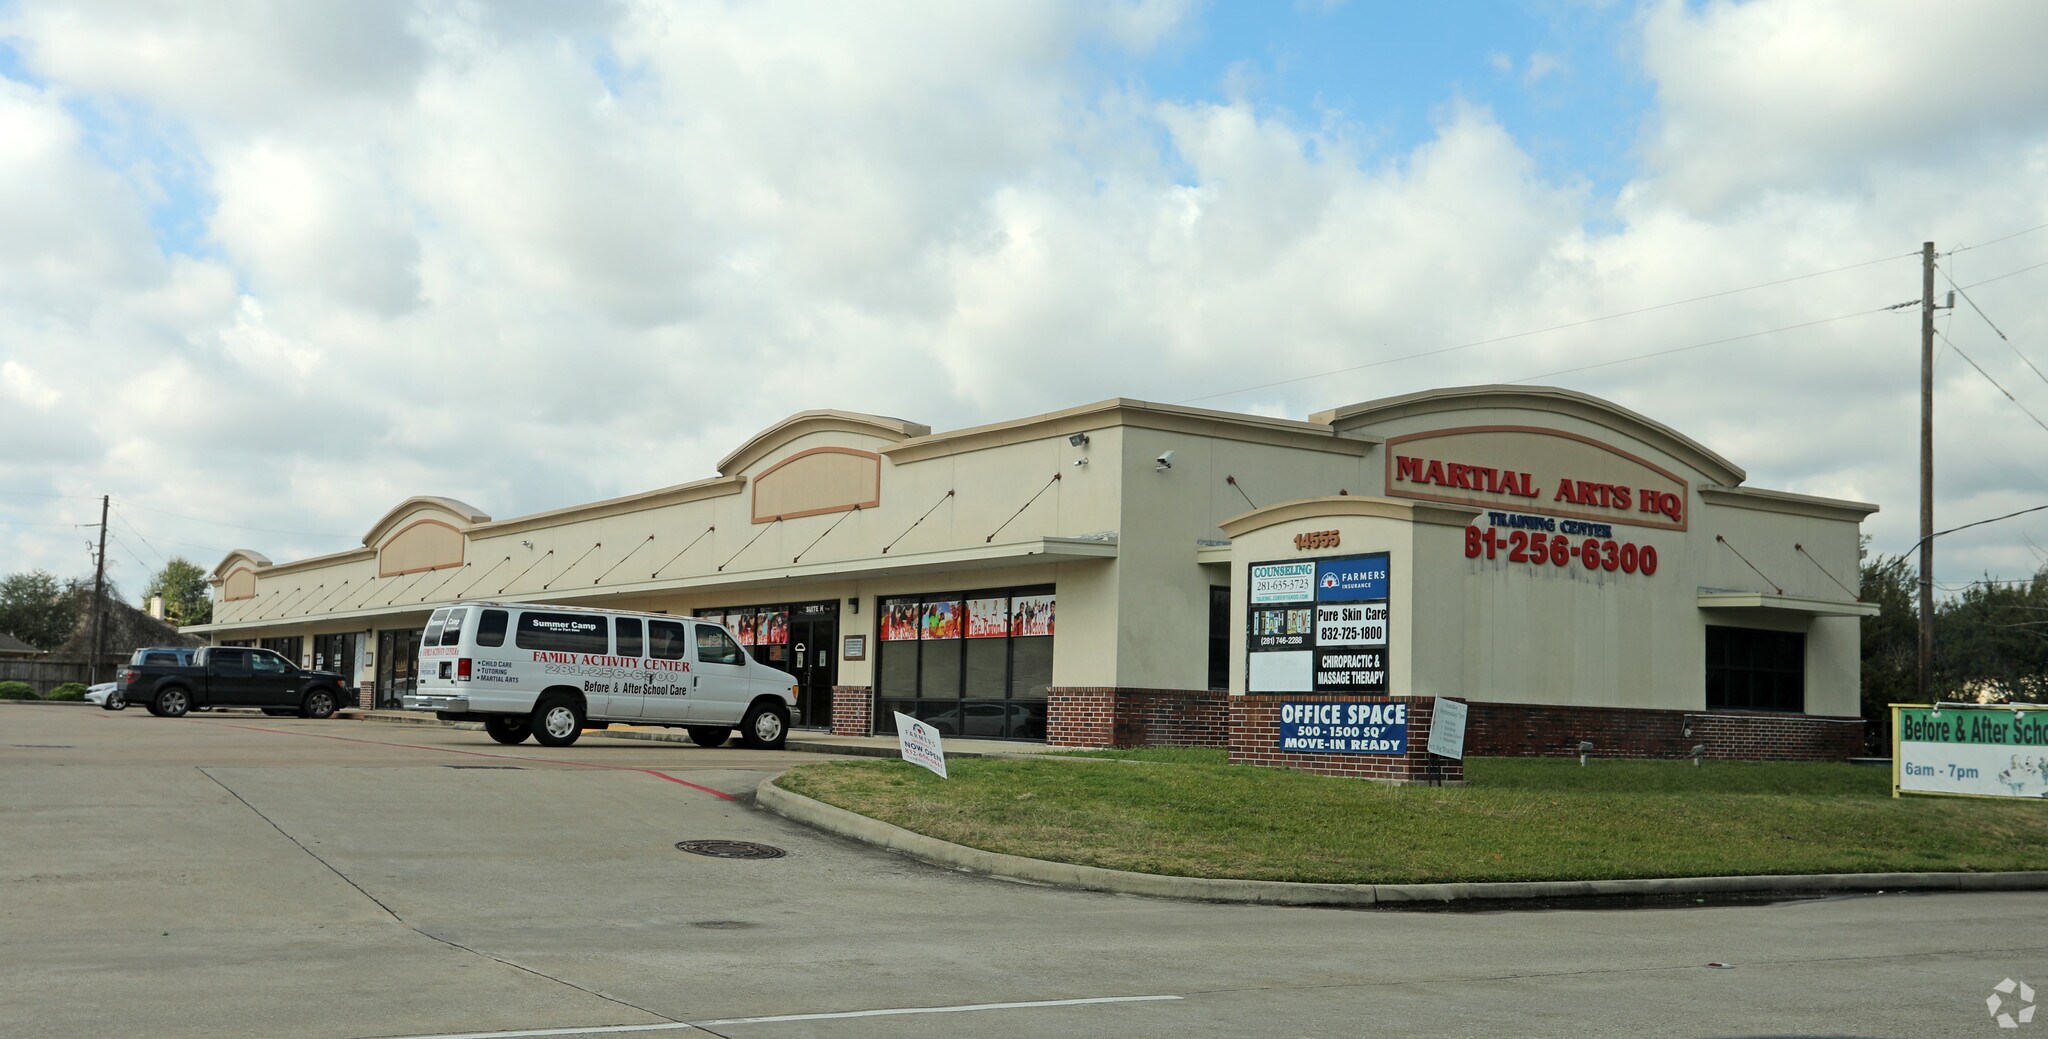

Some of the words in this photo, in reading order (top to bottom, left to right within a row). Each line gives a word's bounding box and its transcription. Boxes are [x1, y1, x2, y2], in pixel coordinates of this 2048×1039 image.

[1396, 455, 1540, 498] MARTIAL
[1554, 479, 1632, 510] ARTS
[1639, 489, 1681, 522] HQ
[1488, 512, 1556, 532] TRAINING
[1560, 520, 1612, 538] CENTER
[1293, 530, 1341, 551] 14555
[1254, 564, 1313, 578] COUNSELING
[1341, 570, 1386, 582] FARMERS
[1256, 579, 1309, 591] 281-635-3723
[1317, 609, 1339, 622] Pure
[1342, 608, 1362, 621] Skin
[1365, 607, 1387, 621] Care
[532, 619, 569, 629] Summer
[571, 621, 596, 631] Camp
[1321, 626, 1382, 640] 832-725-1800
[1260, 637, 1275, 646] (281)
[481, 660, 497, 668] CHILD
[533, 651, 578, 664] FAMILY
[582, 655, 639, 669] ACTIVITY
[644, 659, 690, 672] CENTER
[1321, 654, 1373, 668] CHIROPRACTIC
[1374, 654, 1380, 668] &
[480, 675, 504, 683] MARTIAL
[545, 664, 678, 683] 281-256-6300
[1317, 671, 1350, 685] MASSAGE
[1351, 671, 1384, 684] THERAPY
[584, 680, 609, 693] Before
[614, 682, 618, 693] &
[623, 682, 642, 694] After
[643, 684, 668, 695] School
[670, 684, 687, 696] Care
[1281, 704, 1341, 724] OFFICE
[1347, 704, 1406, 725] SPACE
[1904, 714, 1950, 741] Before
[1955, 715, 1966, 741] &
[1971, 716, 2009, 743] After
[905, 730, 935, 747] FARMERS
[1284, 738, 1345, 750] MOVE-IN
[1350, 740, 1401, 751] READY
[904, 741, 923, 752] NOW
[925, 748, 942, 762] OPEN
[1905, 762, 1935, 776] 6am
[1948, 764, 1979, 780] 7pm
